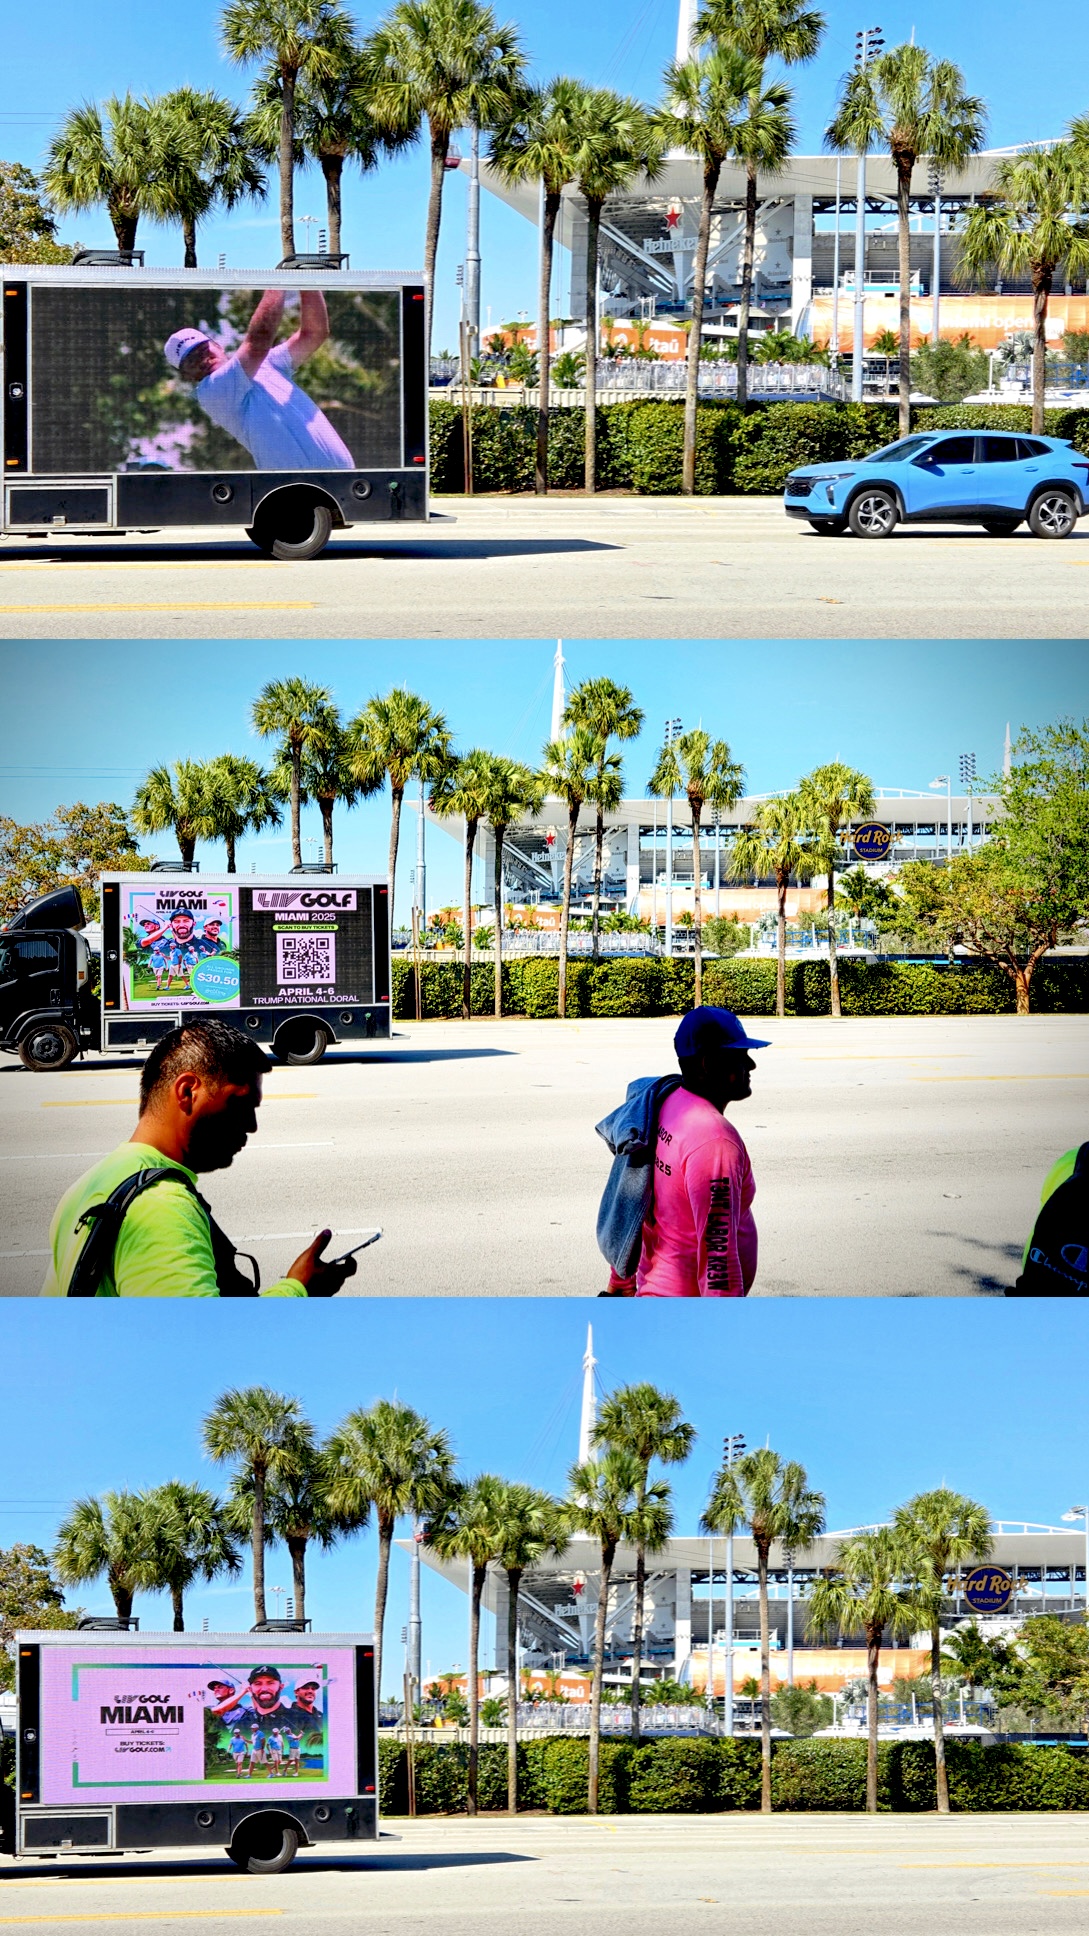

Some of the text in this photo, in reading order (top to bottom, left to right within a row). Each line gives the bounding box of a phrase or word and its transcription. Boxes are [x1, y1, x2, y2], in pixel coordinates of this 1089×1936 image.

[643, 237, 700, 254] Heineke
[840, 830, 904, 846] Hard Rock
[156, 899, 208, 910] MIAMI
[300, 893, 352, 908] GOLF
[274, 912, 336, 921] MIAMI 2025
[196, 972, 239, 986] $30.50
[278, 987, 335, 996] APRIL 4-6
[252, 994, 360, 1005] TRUMP NATIONAL DORAL
[704, 1212, 730, 1253] LABOR
[706, 1255, 730, 1291] KR3W
[946, 1575, 1029, 1594] Hard Rock
[139, 1695, 170, 1703] GOLF
[100, 1706, 184, 1724] MIAMI
